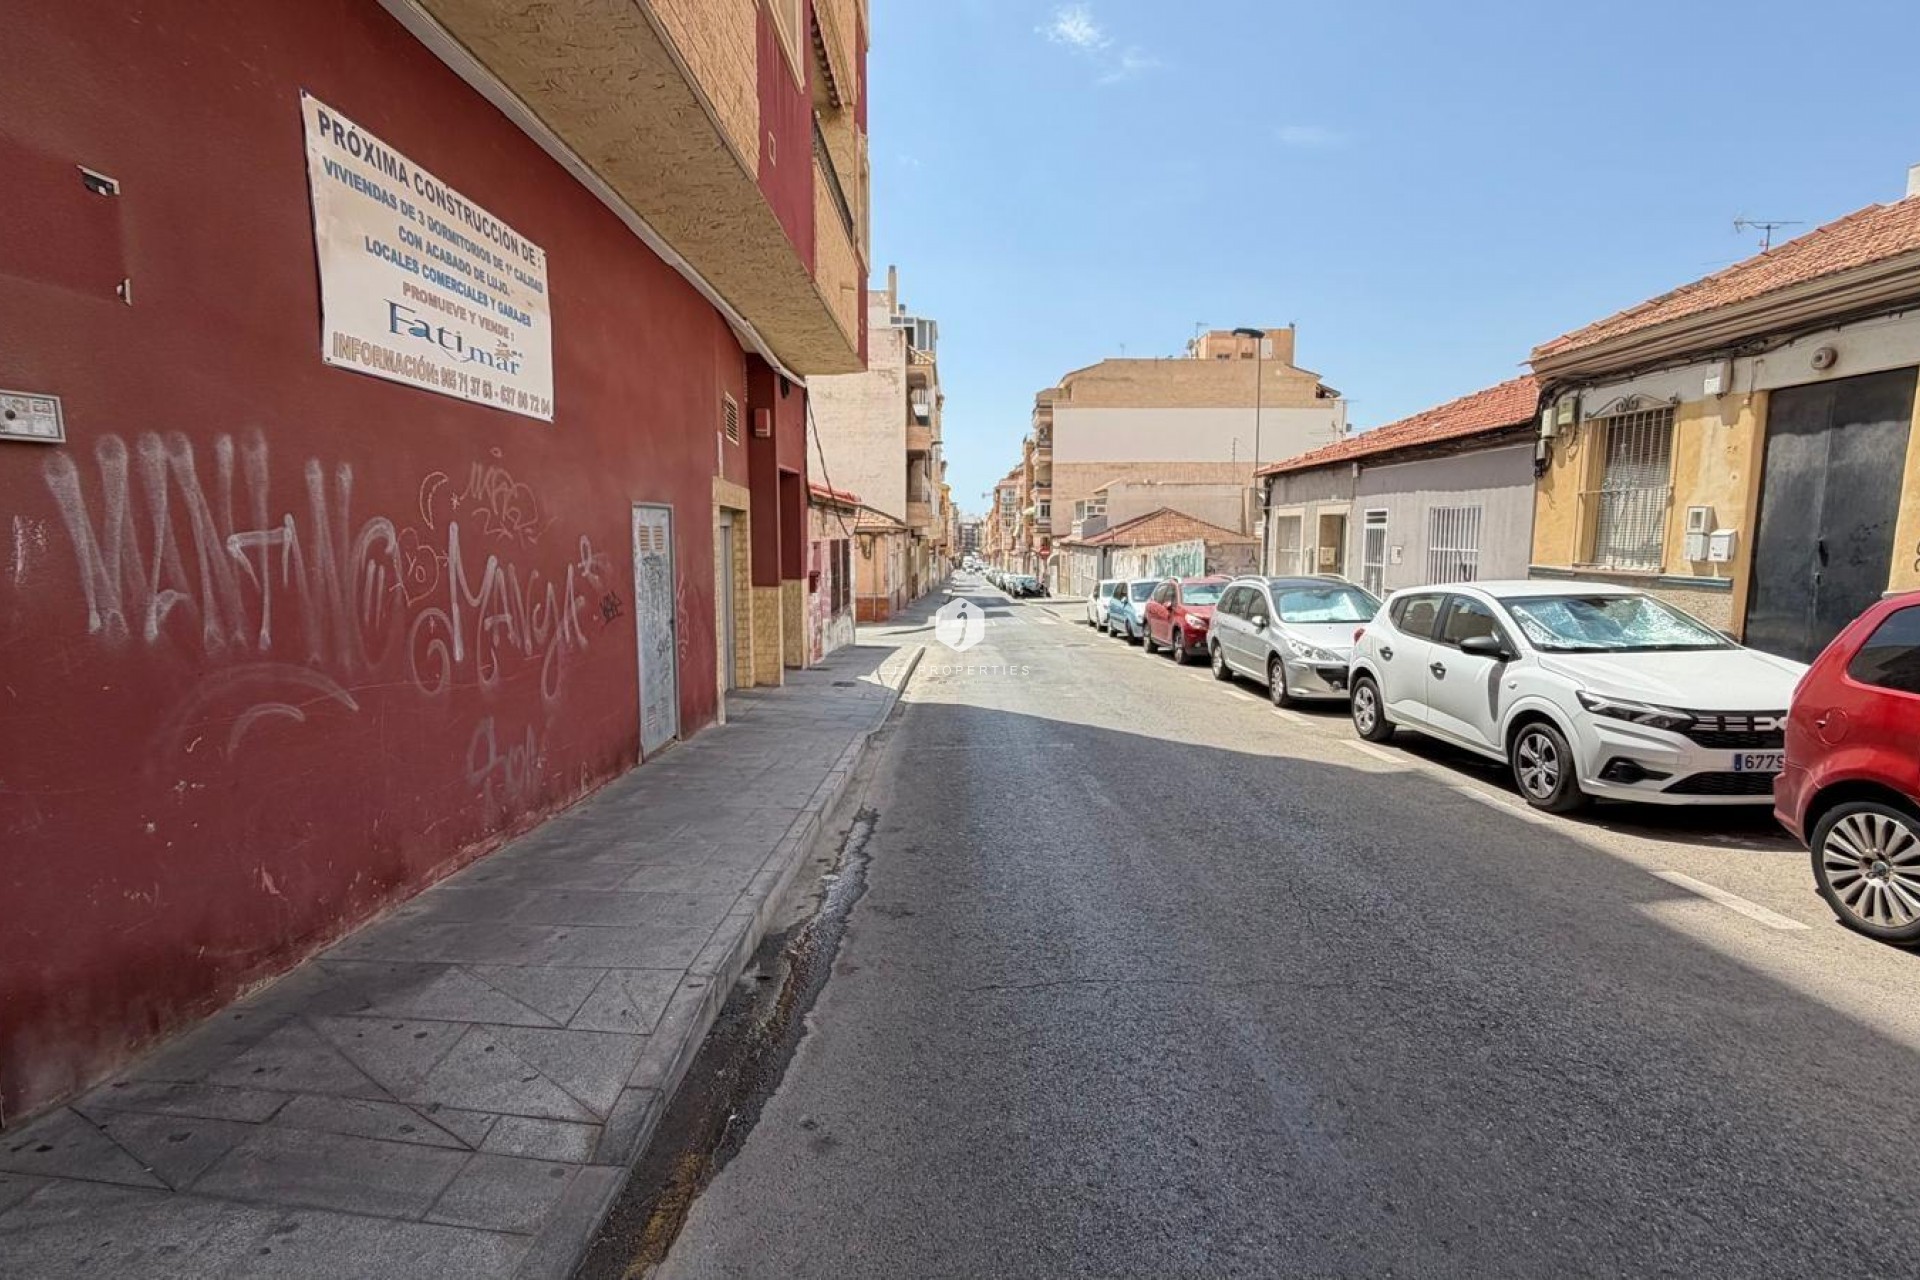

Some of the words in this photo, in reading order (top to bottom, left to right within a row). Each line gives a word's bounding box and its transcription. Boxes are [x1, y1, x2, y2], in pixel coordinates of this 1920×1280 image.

[317, 109, 409, 188] PRÓXIMA
[414, 172, 518, 255] CONSTRUCCIÓN
[323, 156, 397, 210] VIVIENDAS
[400, 200, 416, 221] DE
[417, 210, 426, 226] 3
[428, 216, 491, 264] DORMITORIOS
[493, 255, 503, 271] DE
[365, 236, 419, 275] LOCALES
[422, 264, 487, 306] COMERCIALES
[490, 296, 497, 310] Y
[398, 225, 422, 250] CON
[426, 240, 471, 277] ACABADO
[474, 266, 485, 283] DE
[402, 282, 466, 321] PROMUEVE
[469, 311, 477, 326] Y
